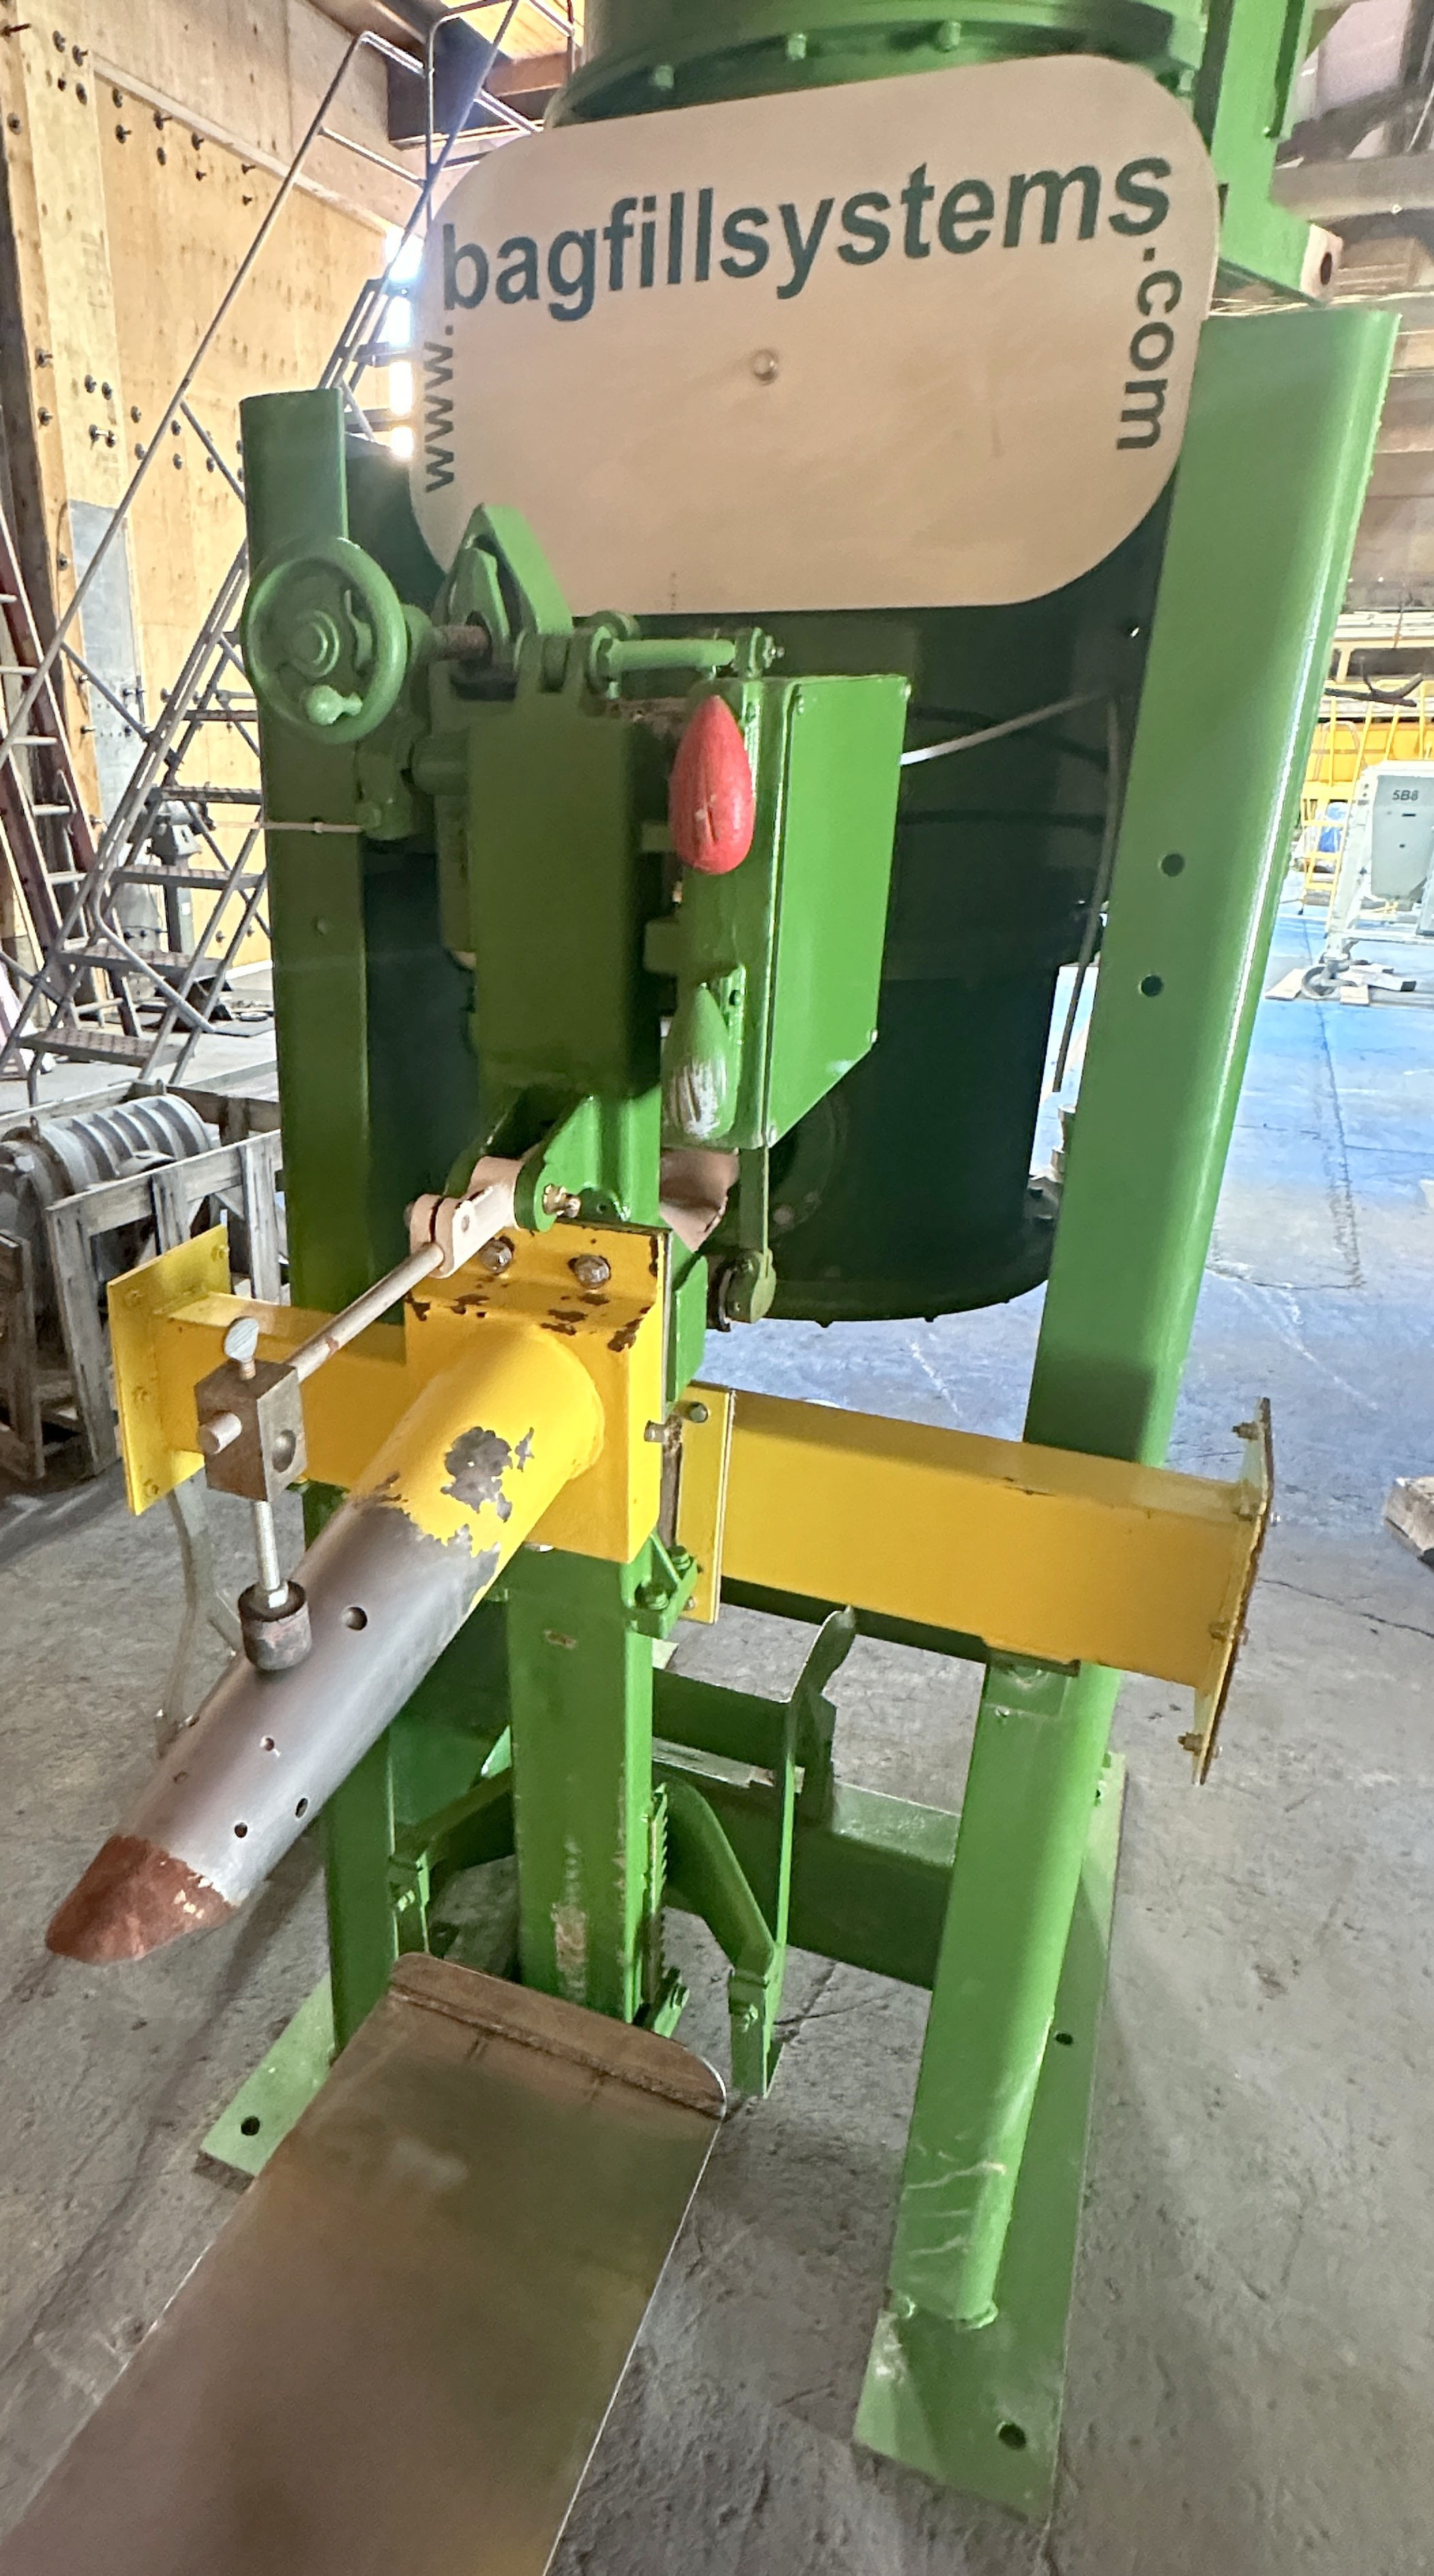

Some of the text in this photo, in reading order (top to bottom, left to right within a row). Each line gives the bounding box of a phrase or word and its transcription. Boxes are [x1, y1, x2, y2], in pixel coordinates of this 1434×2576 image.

[443, 157, 1171, 321] bagfillsystems
[424, 325, 455, 493] www.
[1116, 247, 1182, 450] .com
